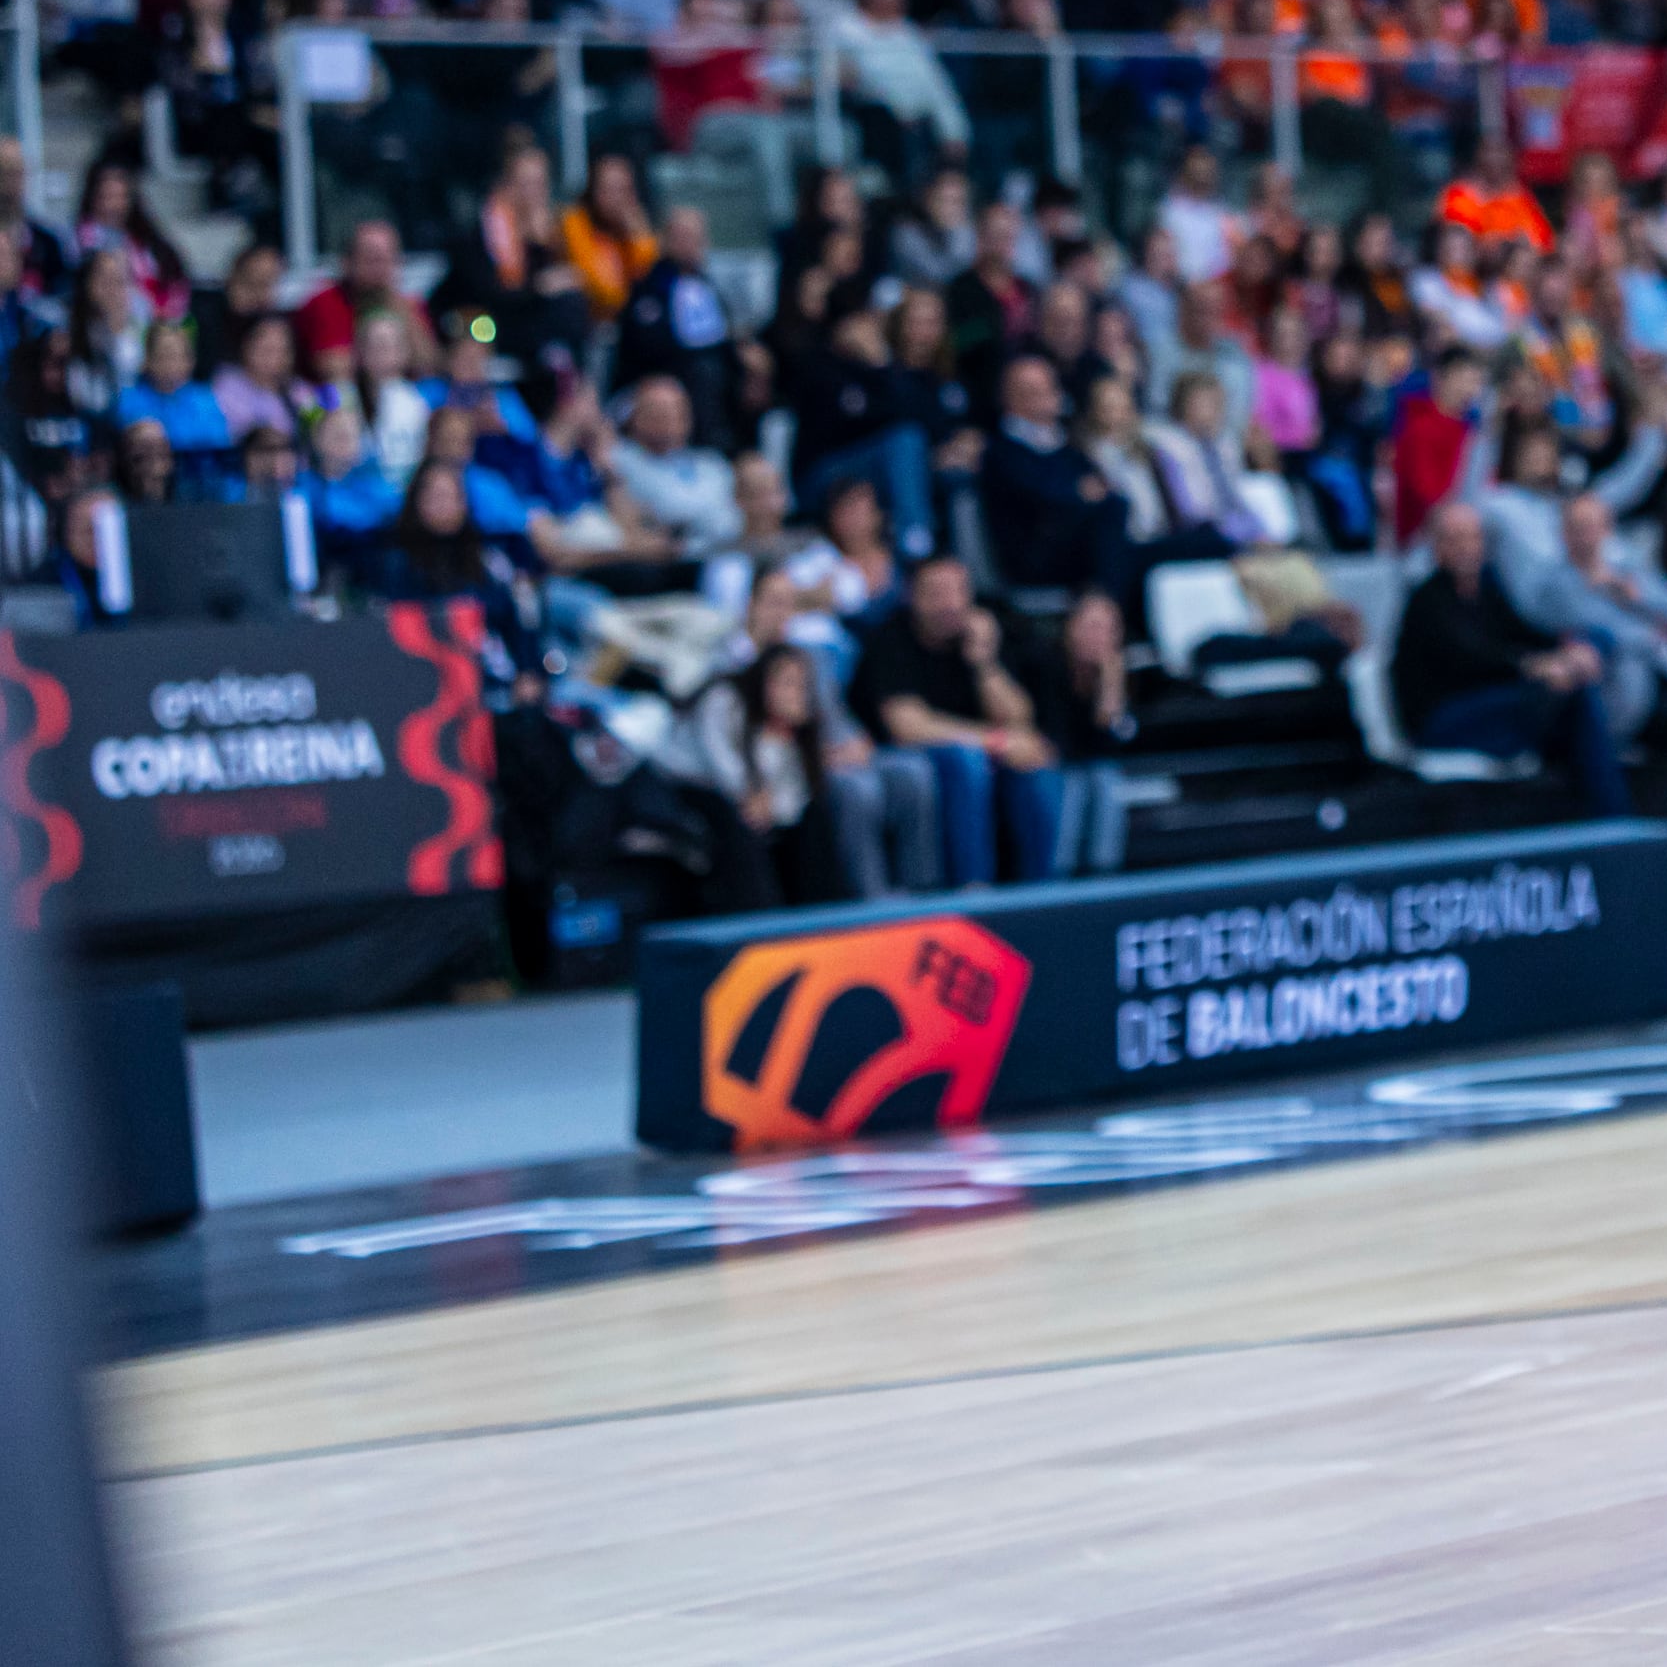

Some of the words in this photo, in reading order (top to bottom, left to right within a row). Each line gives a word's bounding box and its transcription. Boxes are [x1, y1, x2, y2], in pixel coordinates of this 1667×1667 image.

[91, 733, 225, 798] COPA
[1117, 883, 1388, 993] FEDERACIÓN
[1391, 861, 1599, 954] ESPAÑOLA
[1117, 995, 1183, 1071] DE
[1187, 953, 1469, 1059] BALONCESTO
